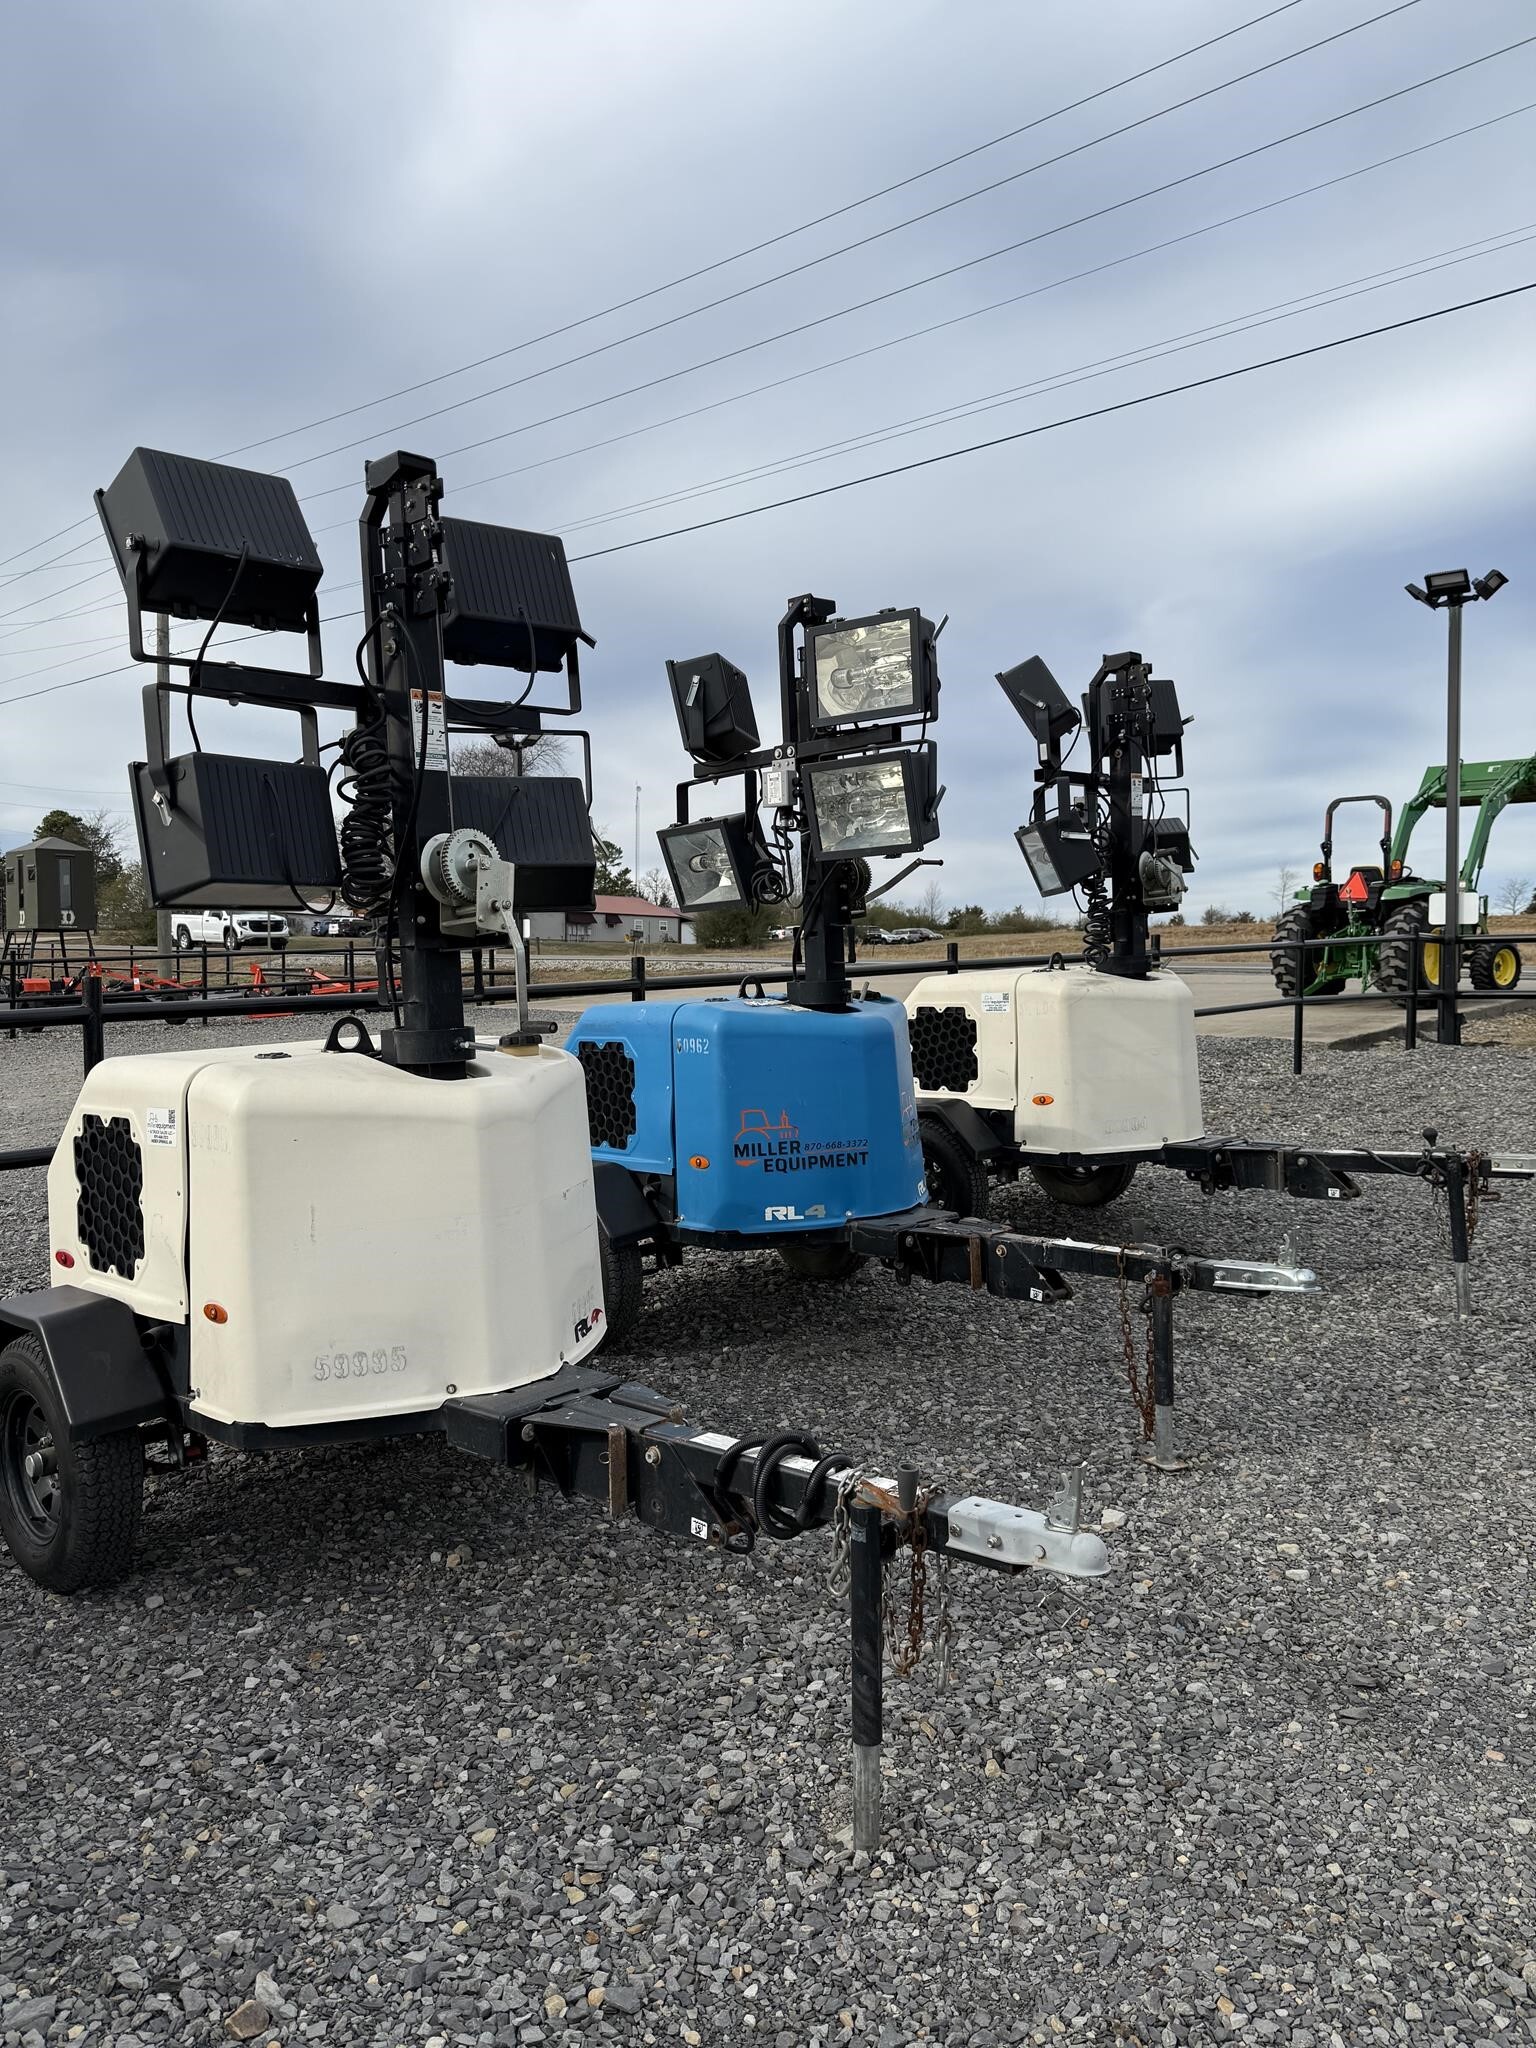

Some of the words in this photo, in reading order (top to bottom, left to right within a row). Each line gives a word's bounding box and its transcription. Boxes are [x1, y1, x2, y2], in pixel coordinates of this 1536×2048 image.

[733, 1140, 801, 1158] MILLER
[804, 1138, 869, 1152] 870-668-3372
[763, 1151, 870, 1173] EQUIPMENT
[764, 1204, 826, 1221] RL4
[313, 1345, 408, 1382] 59995
